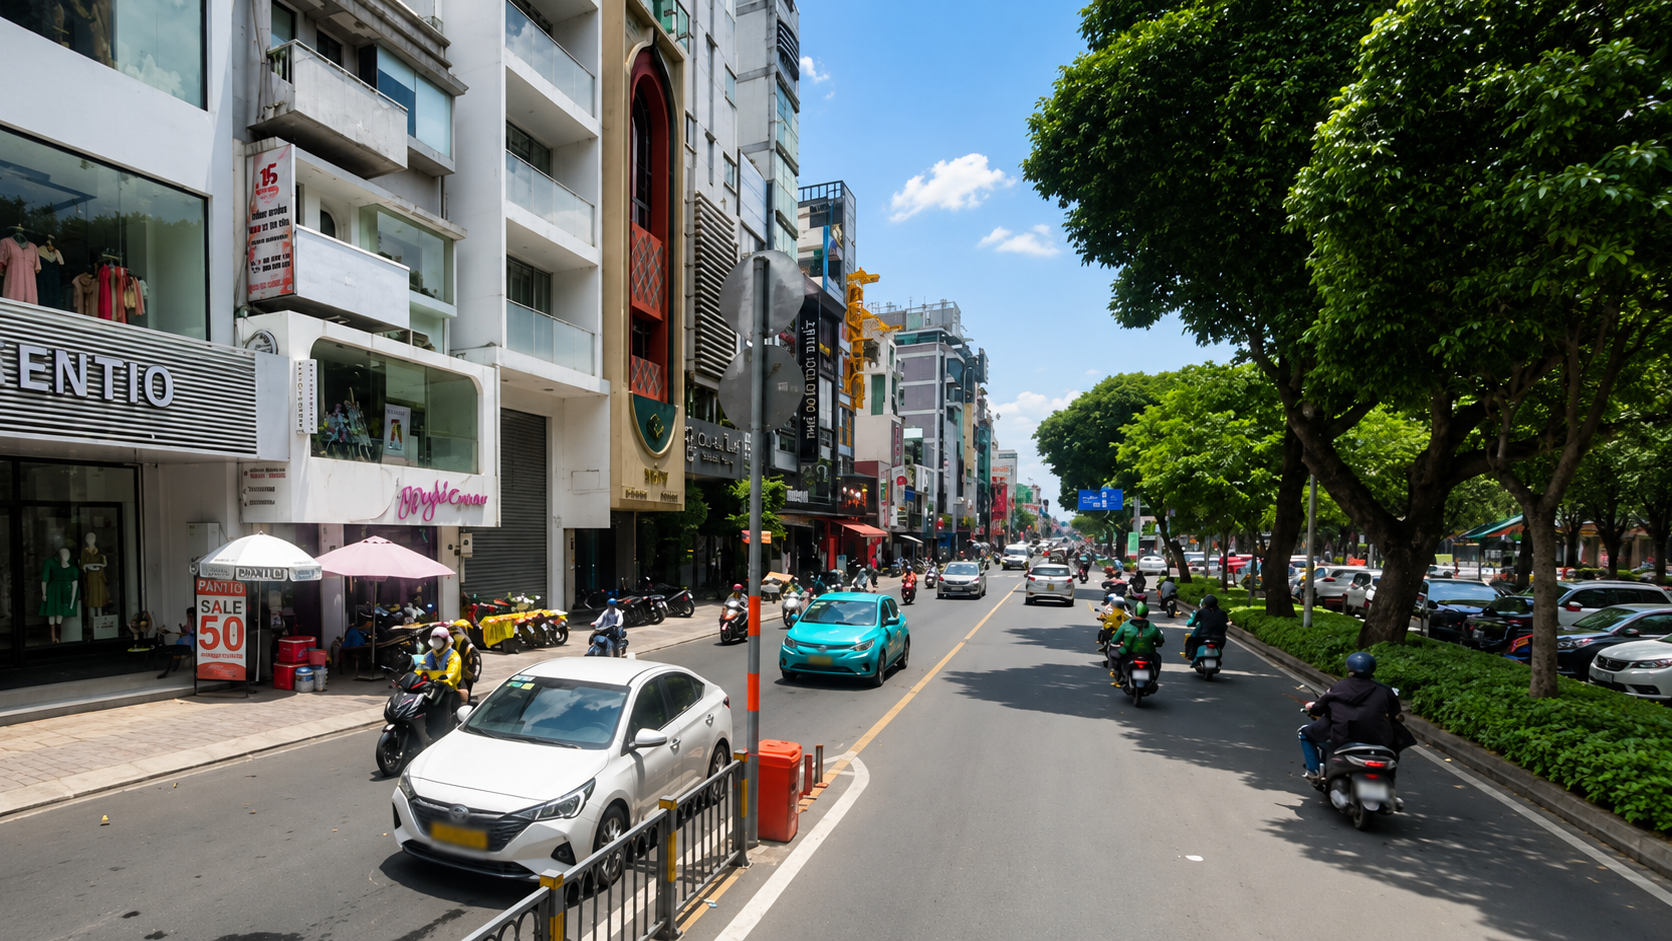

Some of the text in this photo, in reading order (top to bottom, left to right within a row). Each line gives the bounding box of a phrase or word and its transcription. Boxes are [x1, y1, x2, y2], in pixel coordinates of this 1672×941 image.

[0, 341, 175, 409] ENTIO
[201, 600, 243, 615] SALE
[198, 615, 245, 652] 50
